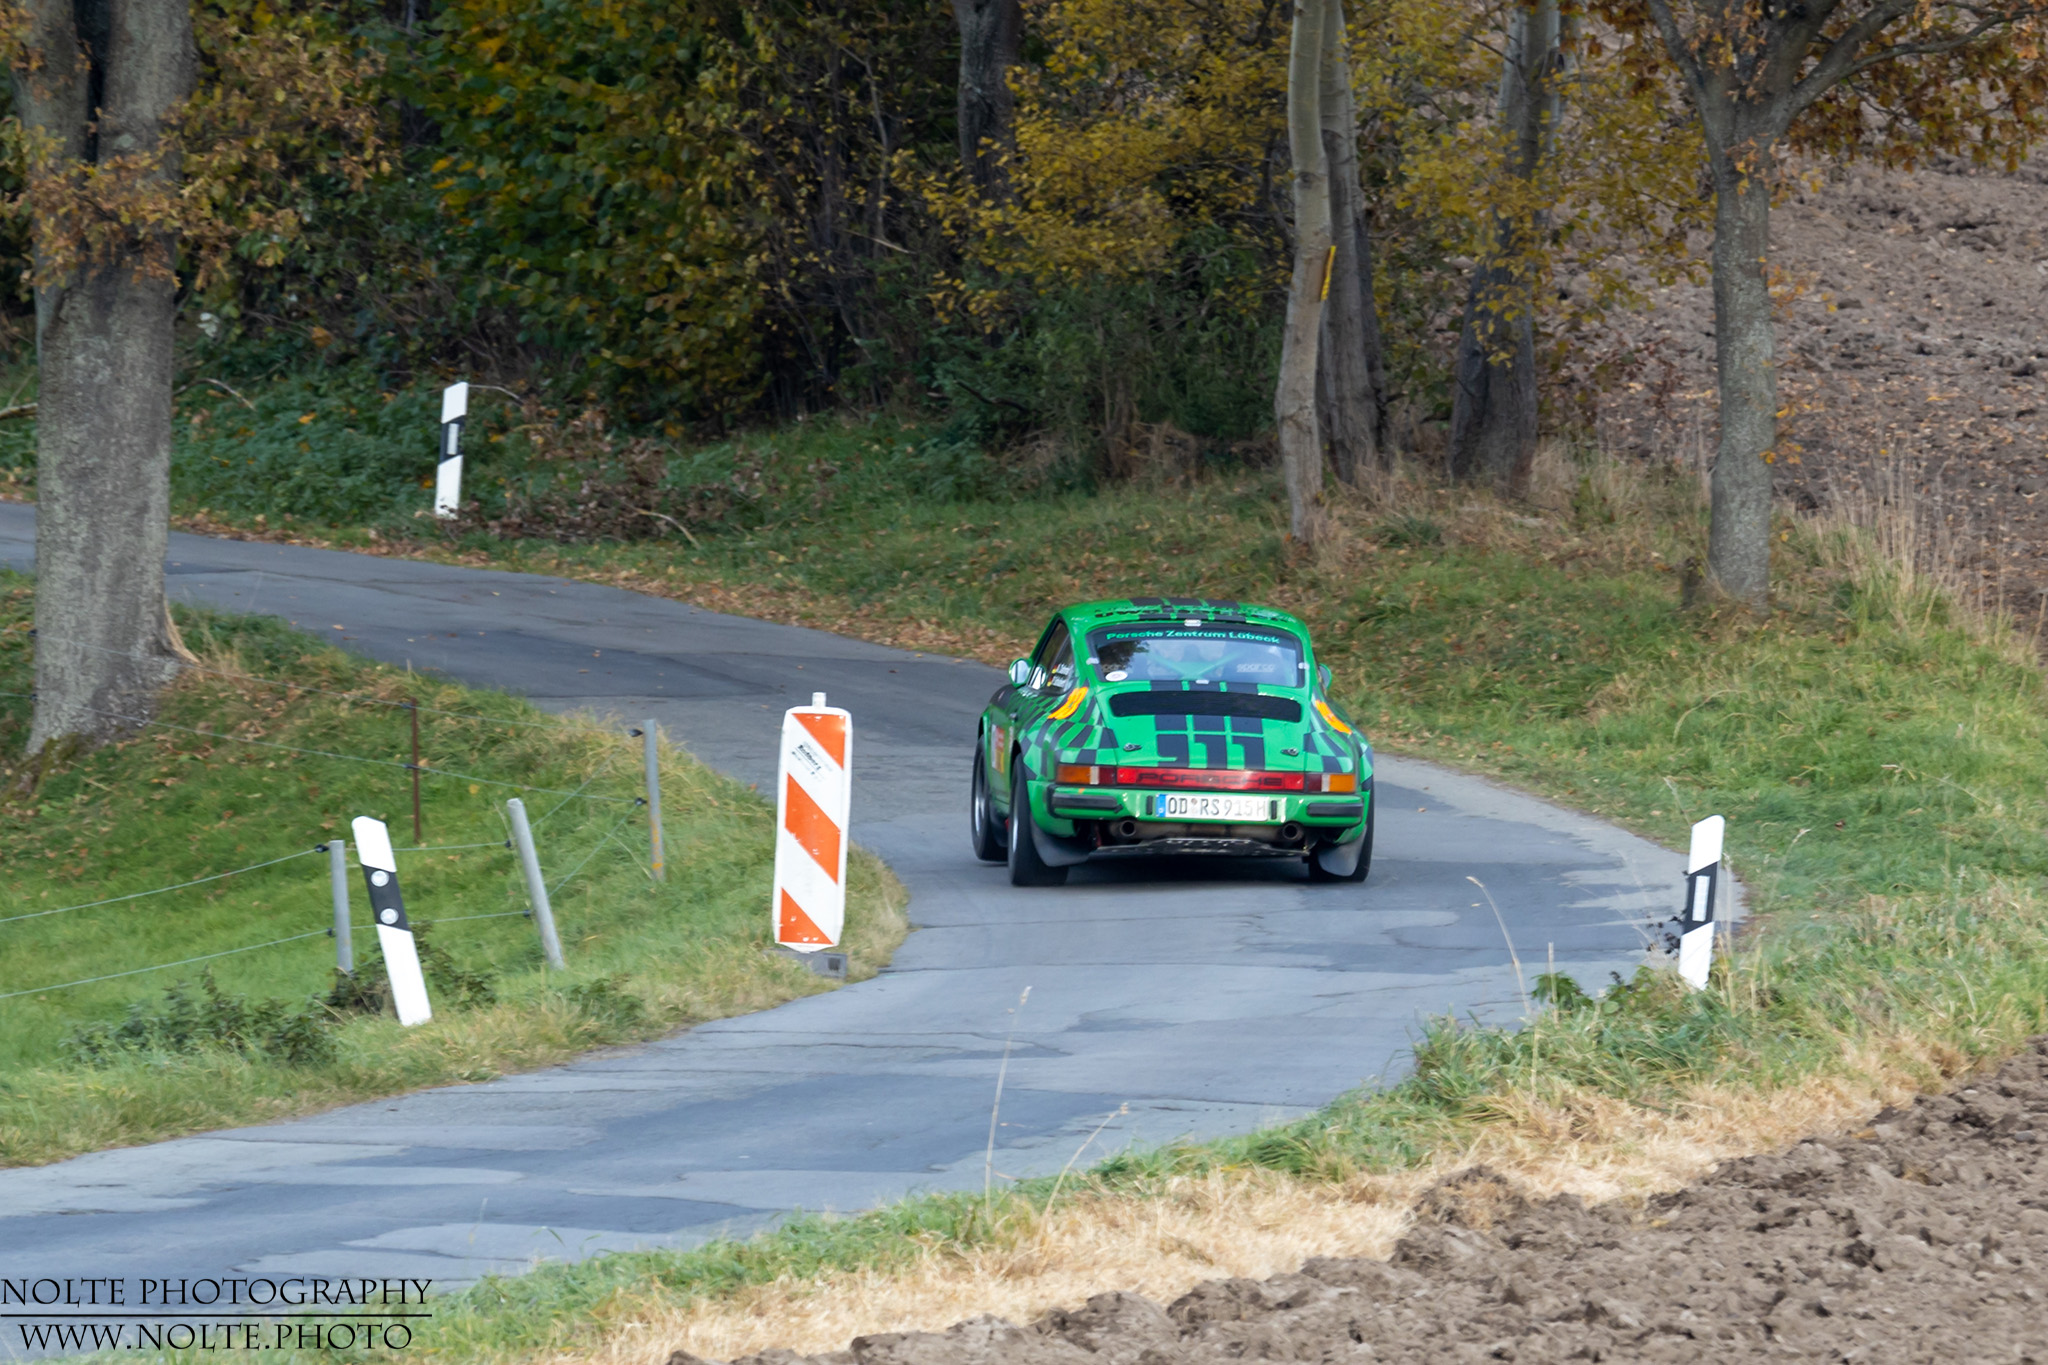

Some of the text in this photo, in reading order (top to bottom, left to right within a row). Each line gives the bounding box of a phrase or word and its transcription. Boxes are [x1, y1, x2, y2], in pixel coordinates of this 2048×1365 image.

[1106, 629, 1280, 644] Porsche Zentrum Lübeck
[1137, 773, 1283, 786] PORSCHE
[1168, 797, 1188, 814] OD
[1200, 798, 1220, 816] RS
